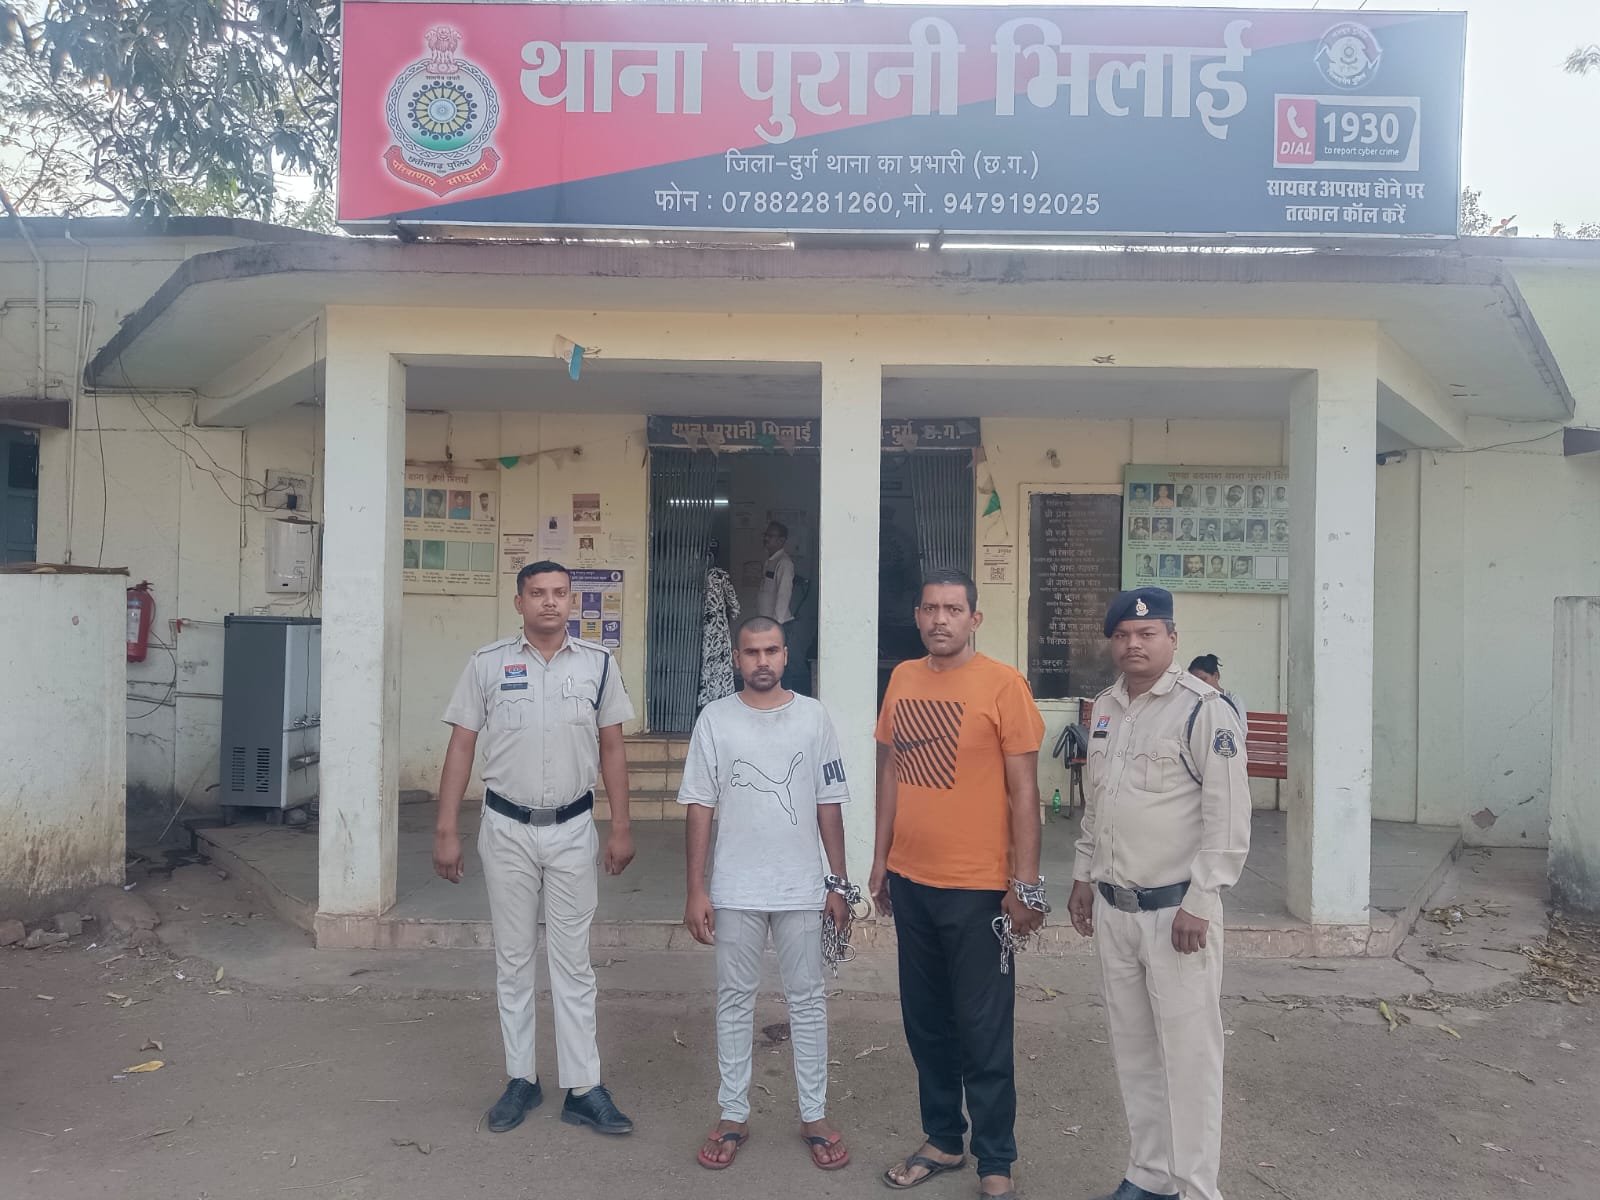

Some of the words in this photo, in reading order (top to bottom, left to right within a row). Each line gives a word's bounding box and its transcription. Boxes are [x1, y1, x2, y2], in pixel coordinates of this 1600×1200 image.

[520, 41, 707, 114] थाना
[732, 17, 965, 144] पुरानी
[991, 17, 1253, 140] भिलाई
[1323, 112, 1400, 145] 1930
[1280, 141, 1313, 155] DIAL
[1334, 147, 1357, 156] report
[1358, 147, 1378, 157] cyber
[1379, 148, 1400, 156] crime
[724, 147, 818, 180] जिला-दुर्ग
[826, 154, 872, 174] थाना
[878, 154, 903, 174] का
[909, 148, 966, 175] प्रभारी
[973, 149, 1040, 180] (छ.ग.)
[655, 181, 700, 212] फोन
[943, 191, 1101, 215] 9479192025
[1266, 180, 1318, 197] सायबर
[1320, 182, 1371, 198] अपराध
[1373, 178, 1402, 199] होने
[1405, 183, 1425, 199] पर
[1285, 205, 1340, 222] तत्काल
[1343, 203, 1379, 224] कॉल
[1382, 203, 1408, 224] करें
[823, 758, 846, 786] PU
